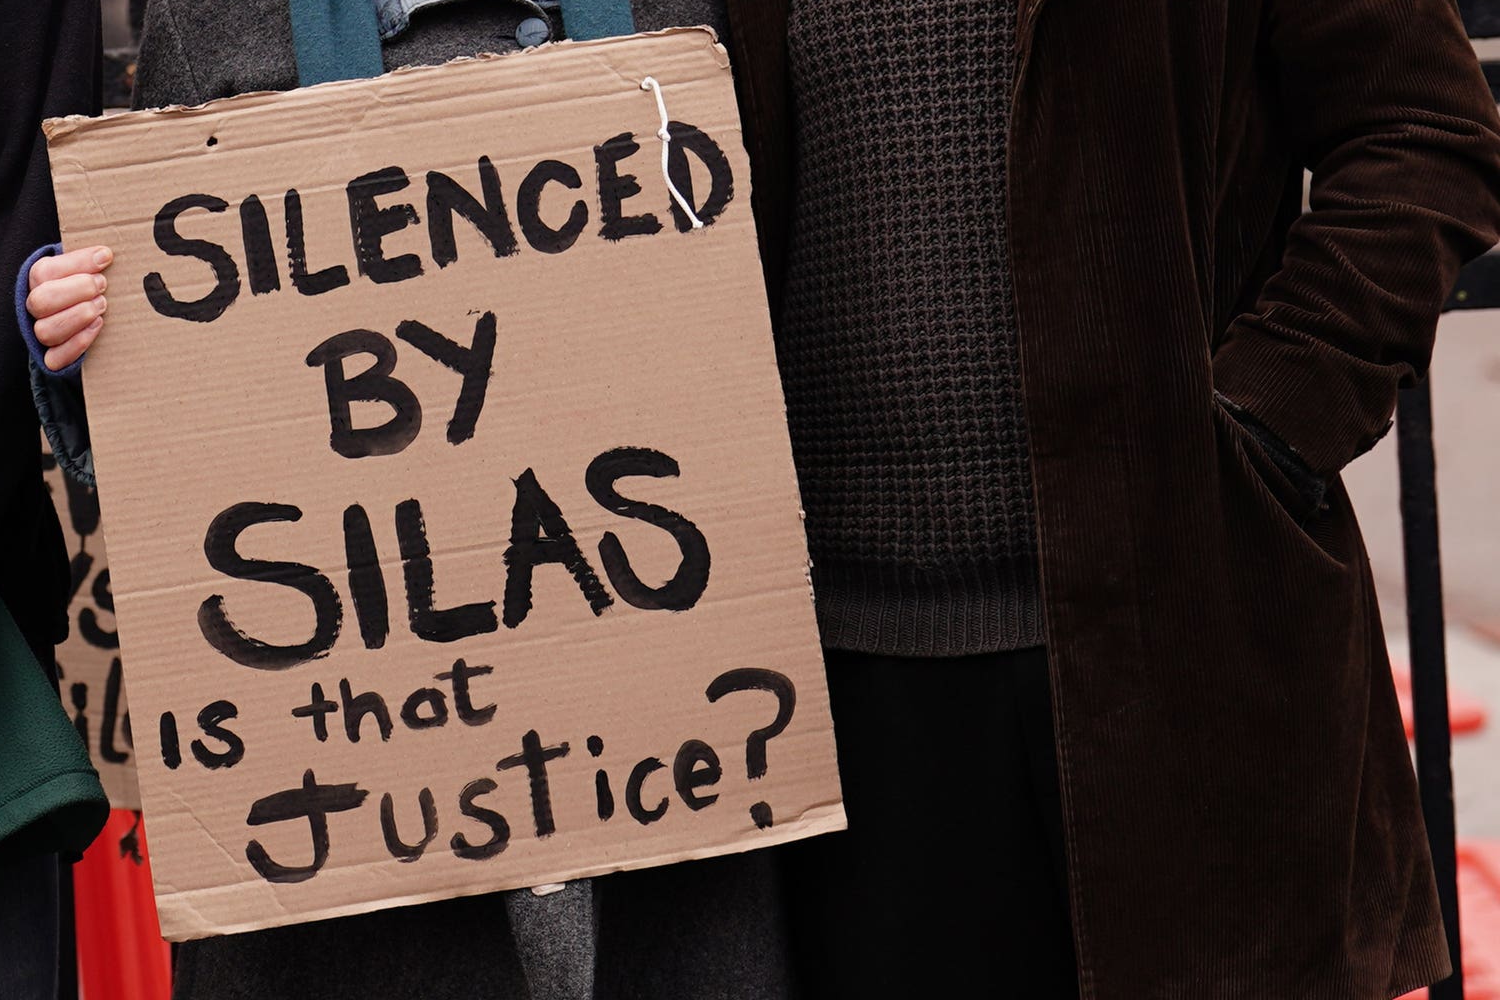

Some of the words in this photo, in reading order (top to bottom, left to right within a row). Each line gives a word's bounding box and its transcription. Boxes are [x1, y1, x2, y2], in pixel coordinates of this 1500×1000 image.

[143, 120, 735, 323] SILENCED
[306, 311, 497, 459] BY
[197, 447, 711, 670] SILAS
[292, 658, 498, 742] that
